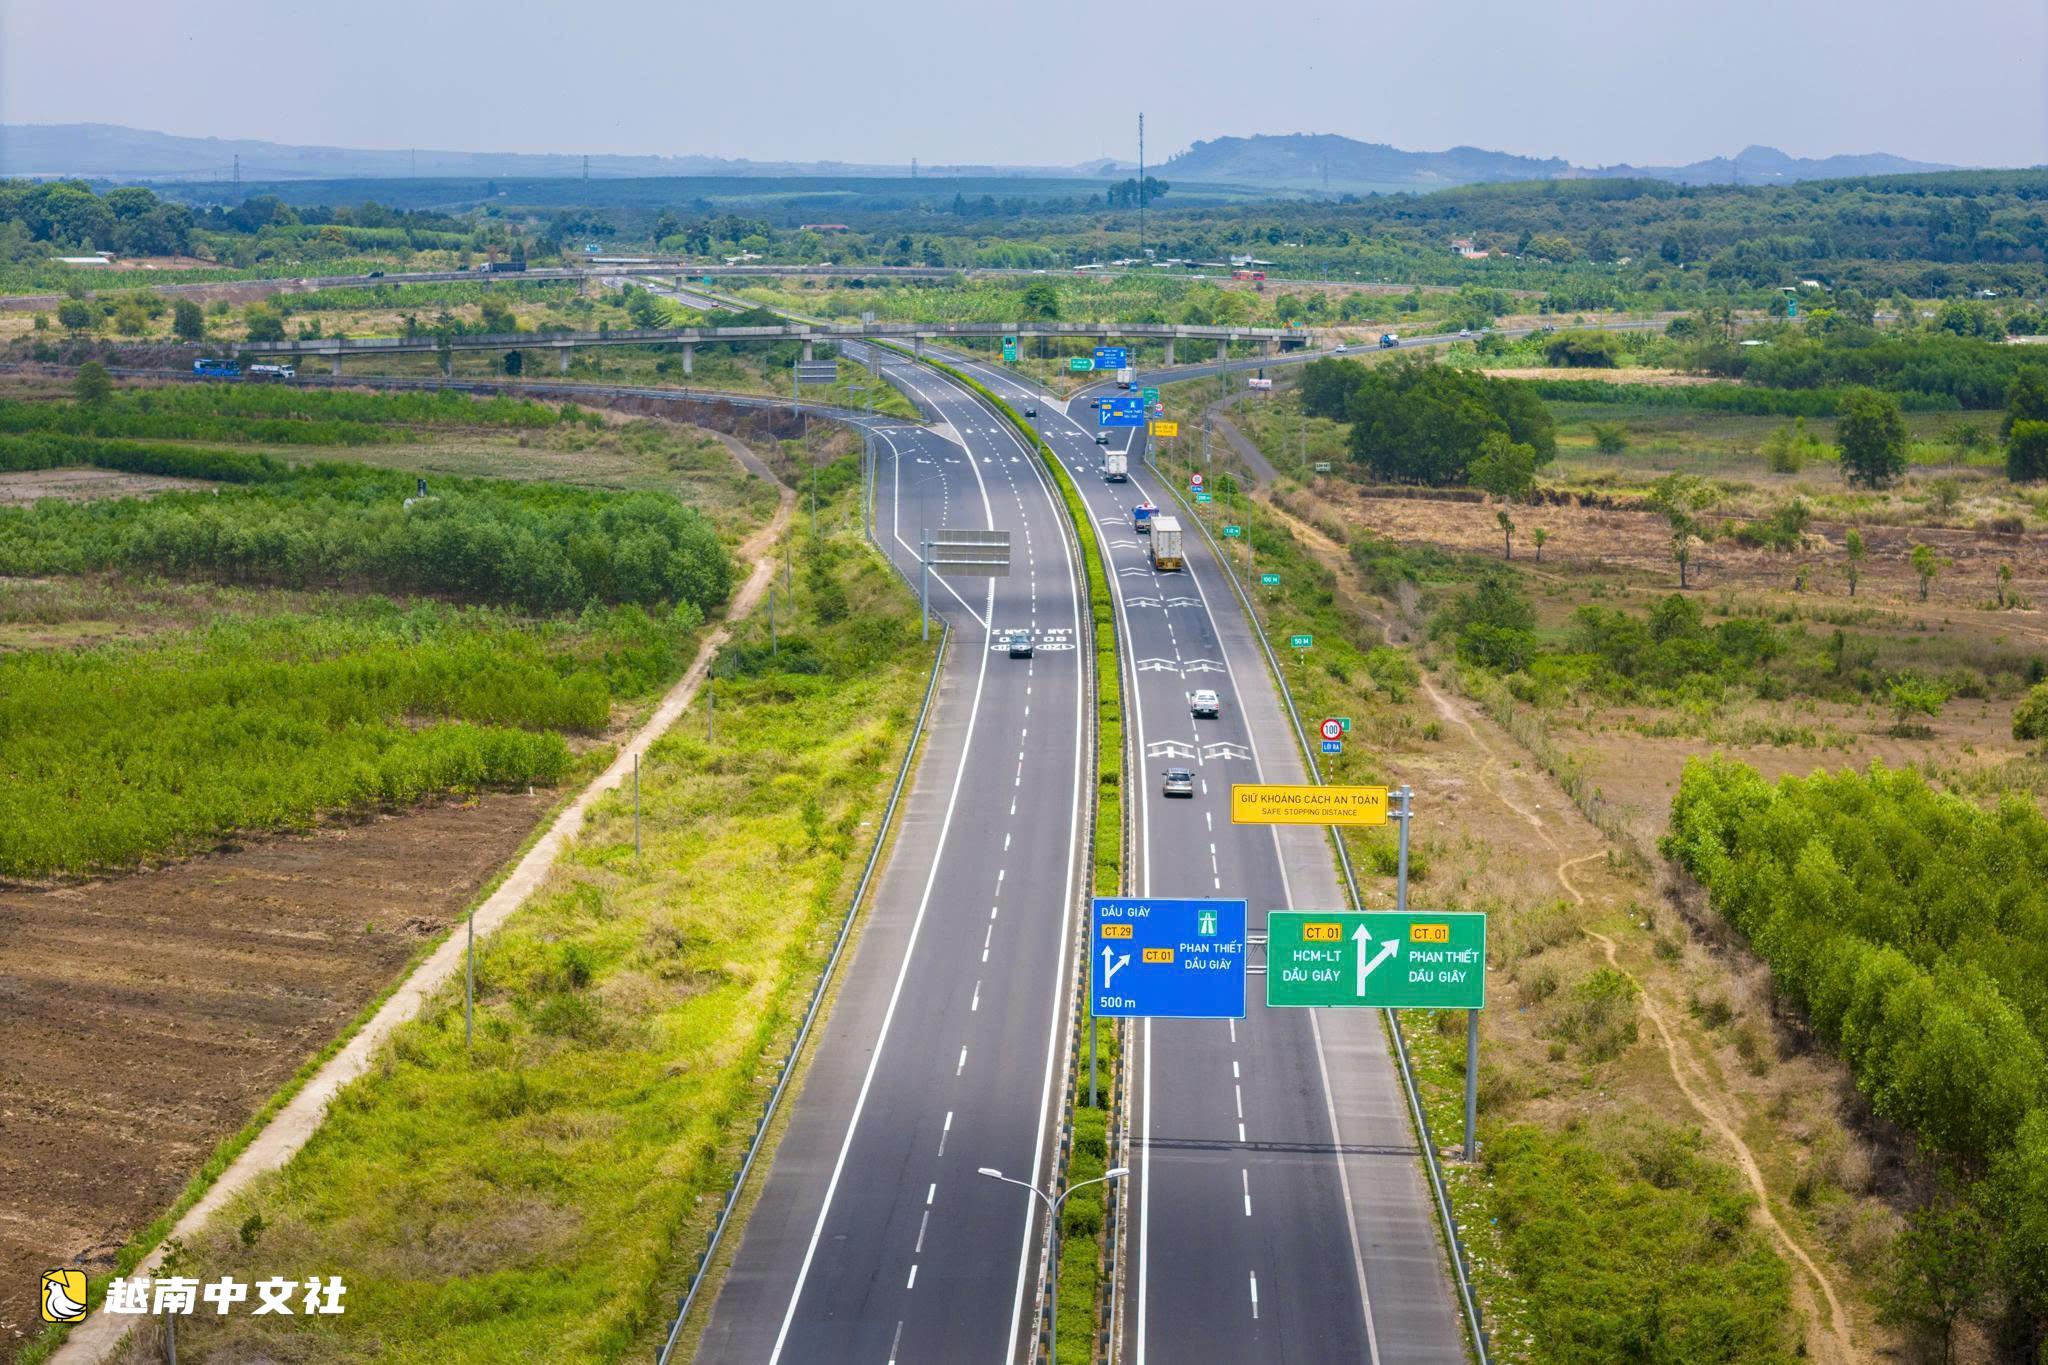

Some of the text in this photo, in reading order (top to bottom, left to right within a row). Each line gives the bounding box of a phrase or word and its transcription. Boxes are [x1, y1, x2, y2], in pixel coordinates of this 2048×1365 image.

[1325, 724, 1338, 735] 100
[1334, 795, 1348, 805] AN
[1262, 807, 1357, 817] SAFE STOPPING DISTANCE
[1127, 905, 1151, 918] GIÂY
[1104, 926, 1131, 937] CT.29
[1179, 939, 1243, 954] PHAN THIẾT
[1293, 950, 1342, 962] HCM-LT
[1409, 948, 1480, 964] PHAN THIẾT
[1209, 958, 1232, 970] GIÂY
[1312, 968, 1341, 982] GIÂY
[1438, 970, 1467, 984] GIÂY
[1100, 996, 1136, 1008] 500 m
